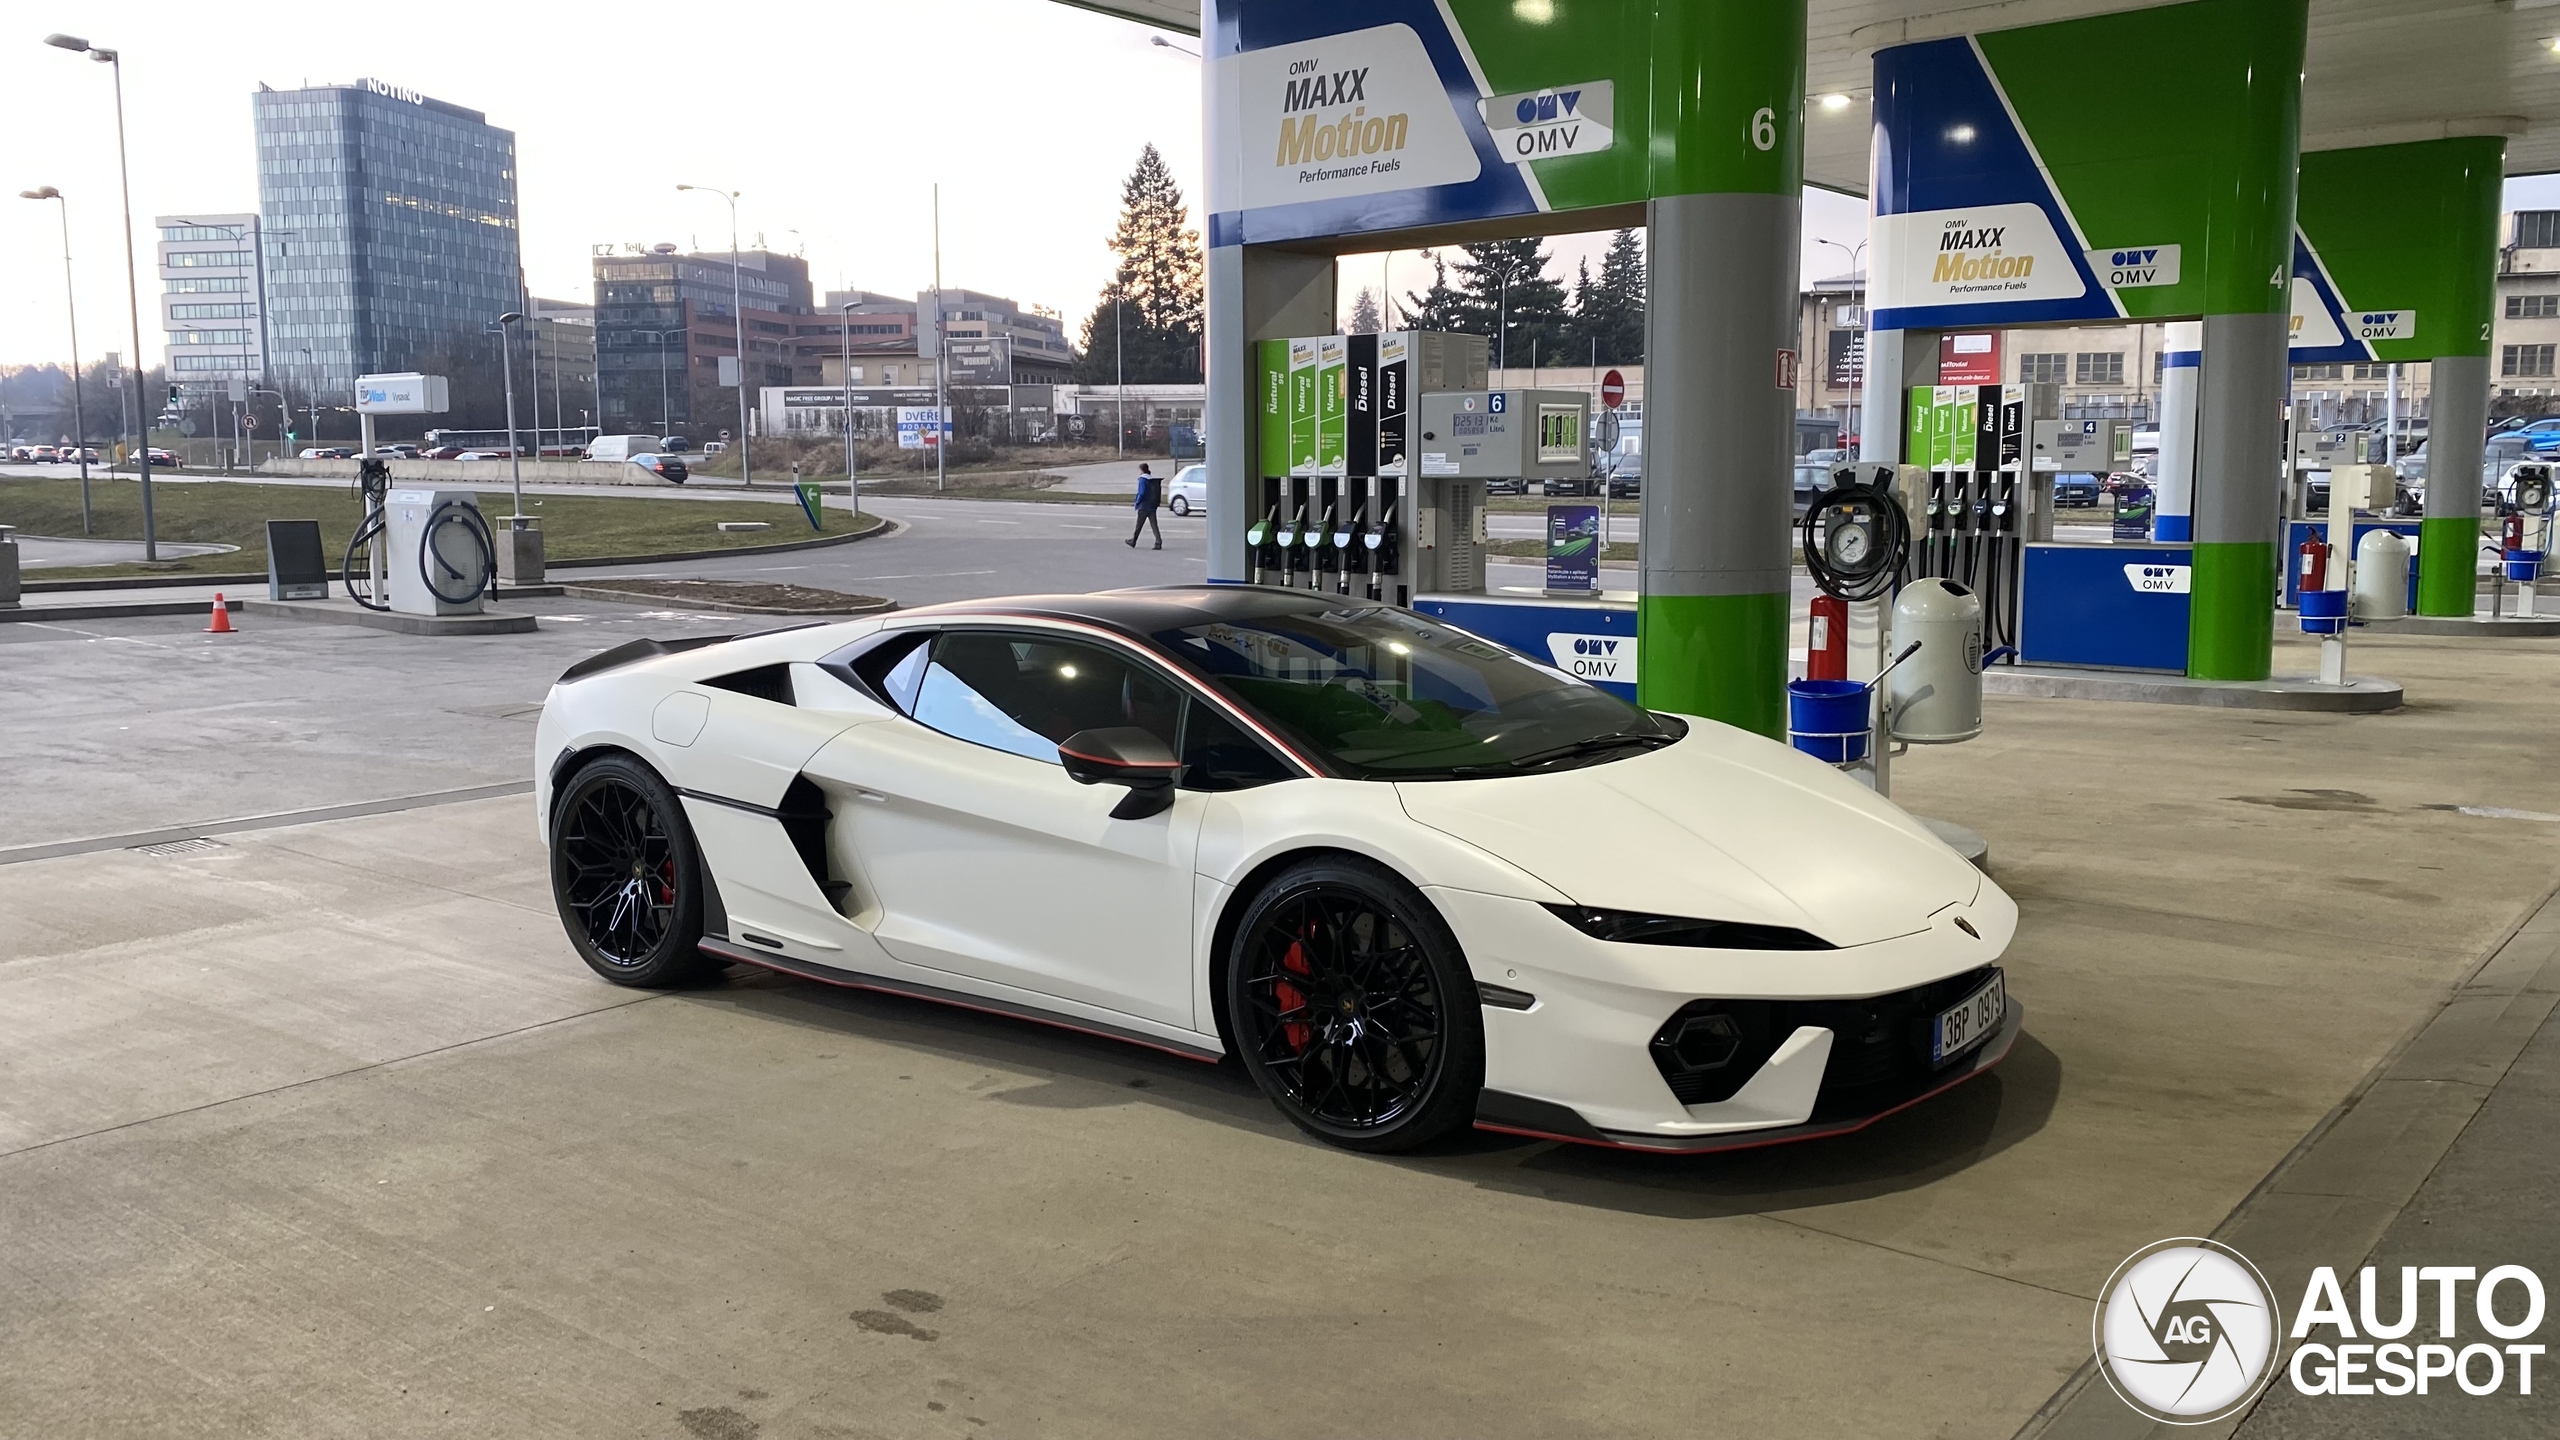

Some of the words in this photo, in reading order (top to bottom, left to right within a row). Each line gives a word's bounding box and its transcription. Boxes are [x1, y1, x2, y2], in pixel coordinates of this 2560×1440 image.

[1289, 58, 1319, 75] OMV
[366, 77, 423, 105] NOTINO
[1284, 67, 1370, 113] MAXX
[1276, 106, 1409, 167] Motion
[1516, 125, 1580, 155] OMV
[1751, 107, 1776, 150] 6
[1299, 164, 1368, 183] Performance
[1371, 158, 1401, 174] Fuels
[1945, 220, 1968, 229] OMV
[1940, 227, 2006, 251] MAXX
[1932, 250, 2035, 283] Motion
[2111, 269, 2156, 284] OMV
[2269, 265, 2284, 289] 4
[1950, 284, 2003, 293] Performance
[2004, 281, 2027, 291] Fuels
[2361, 327, 2397, 338] OMV
[2480, 323, 2490, 341] 2
[963, 356, 991, 365] WORKOUT
[1278, 373, 1284, 385] 95
[1306, 378, 1311, 388] 95
[1358, 366, 1368, 412] Diesel
[1387, 371, 1396, 410] Diesel
[1269, 370, 1278, 414] Natural
[1298, 376, 1306, 413] Natural
[1327, 374, 1335, 412] Natural
[1492, 395, 1502, 412] 6
[905, 408, 939, 421] DVEŘE
[1916, 405, 1924, 433] Natural
[1985, 403, 1994, 432] Diesel
[2007, 407, 2016, 431] Diesel
[2085, 422, 2094, 433] 4
[2338, 434, 2344, 442] 2
[2142, 580, 2174, 590] OMV
[1573, 660, 1617, 677] OMV
[1945, 1005, 1970, 1049] 3BP
[1977, 982, 2001, 1029] 0979
